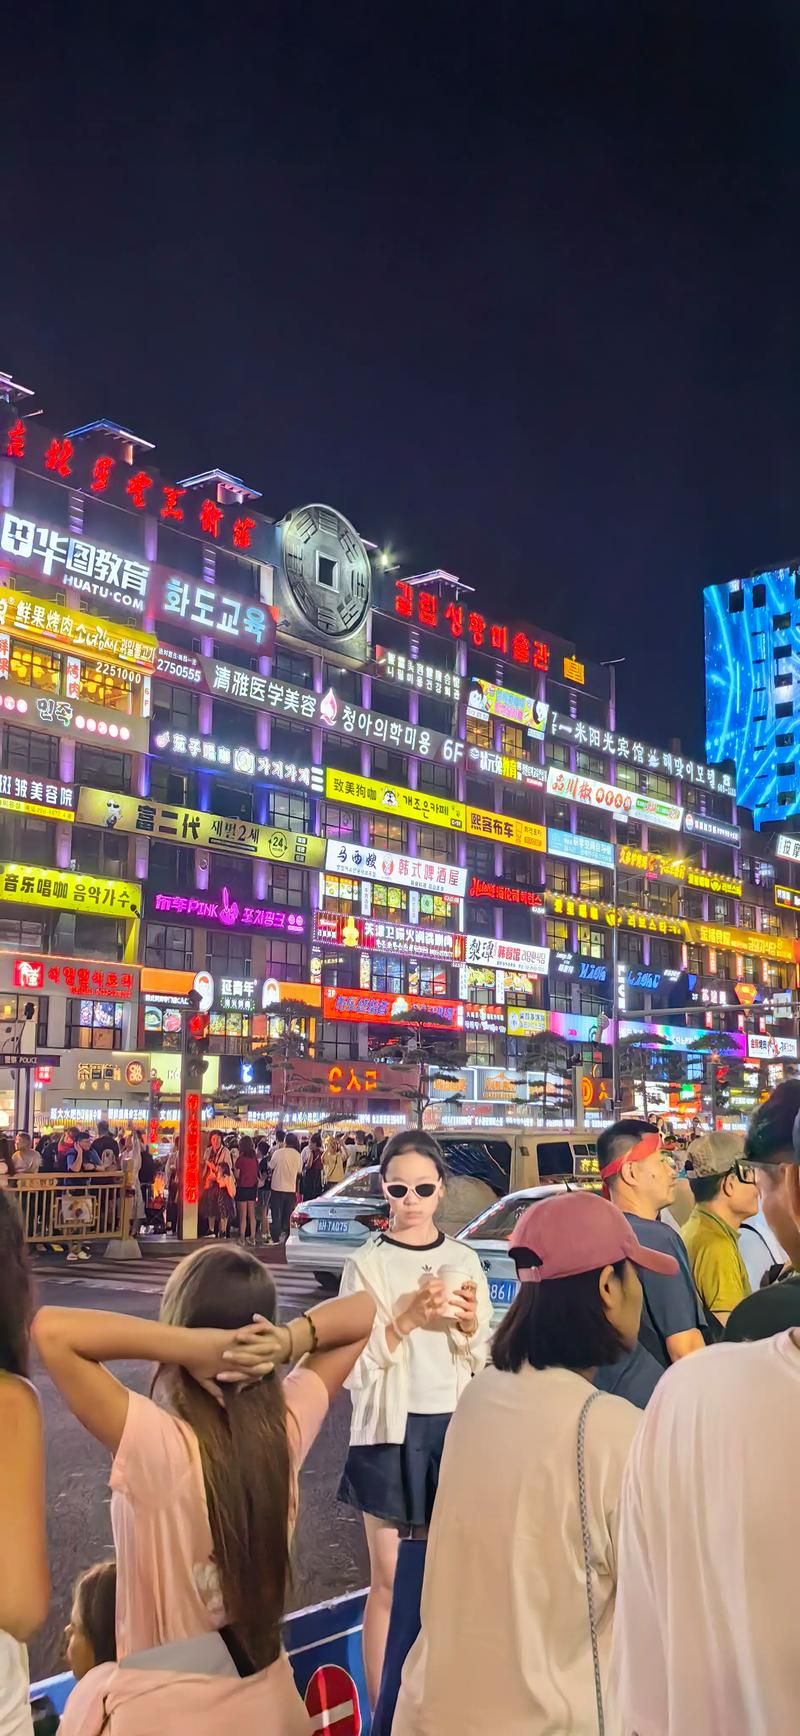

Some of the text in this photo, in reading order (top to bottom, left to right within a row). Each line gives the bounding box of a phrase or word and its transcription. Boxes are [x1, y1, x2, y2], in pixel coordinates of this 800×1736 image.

[32, 527, 151, 596] 华图教育
[16, 600, 73, 635] 鲜果烤肉
[164, 576, 266, 644] 화도교육
[95, 662, 141, 684] 2251000
[157, 659, 202, 682] 2750555
[37, 698, 73, 726] 민족
[213, 665, 464, 763] 清雅医学美容 청아의학미용 6F
[558, 722, 644, 763] 一米阳光宾馆
[333, 778, 377, 801] 致美狗咖
[136, 804, 200, 840] 富二代
[398, 858, 460, 887] 韩式啤酒屋
[4, 873, 130, 908] 音乐唱咖 음악가수
[221, 978, 254, 997] 延青年
[488, 1284, 512, 1302] 861
